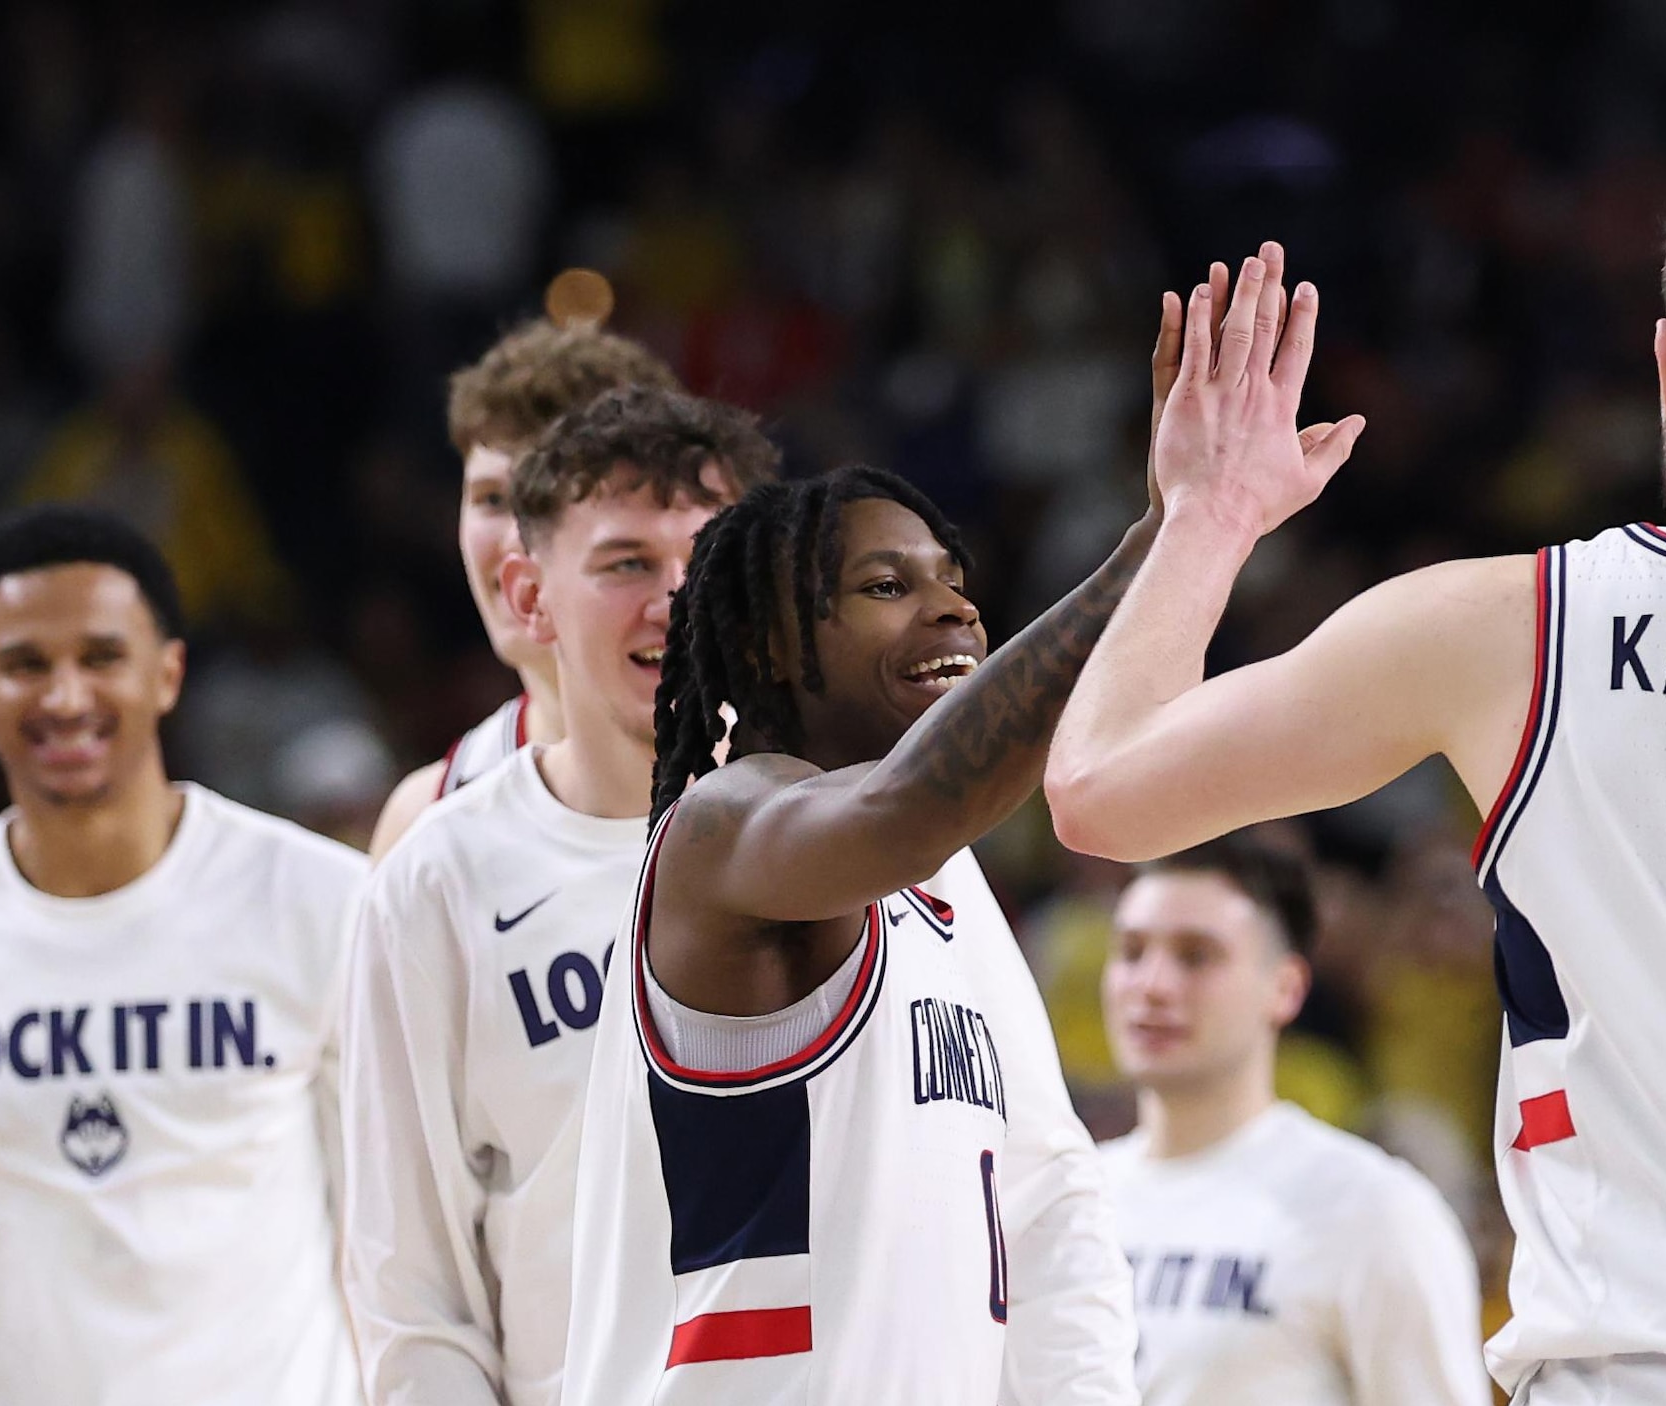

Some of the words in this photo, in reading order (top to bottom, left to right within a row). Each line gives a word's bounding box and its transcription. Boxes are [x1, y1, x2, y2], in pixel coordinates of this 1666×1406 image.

[115, 1005, 168, 1071] IT
[191, 1000, 276, 1068] IN.
[508, 938, 615, 1047] LO
